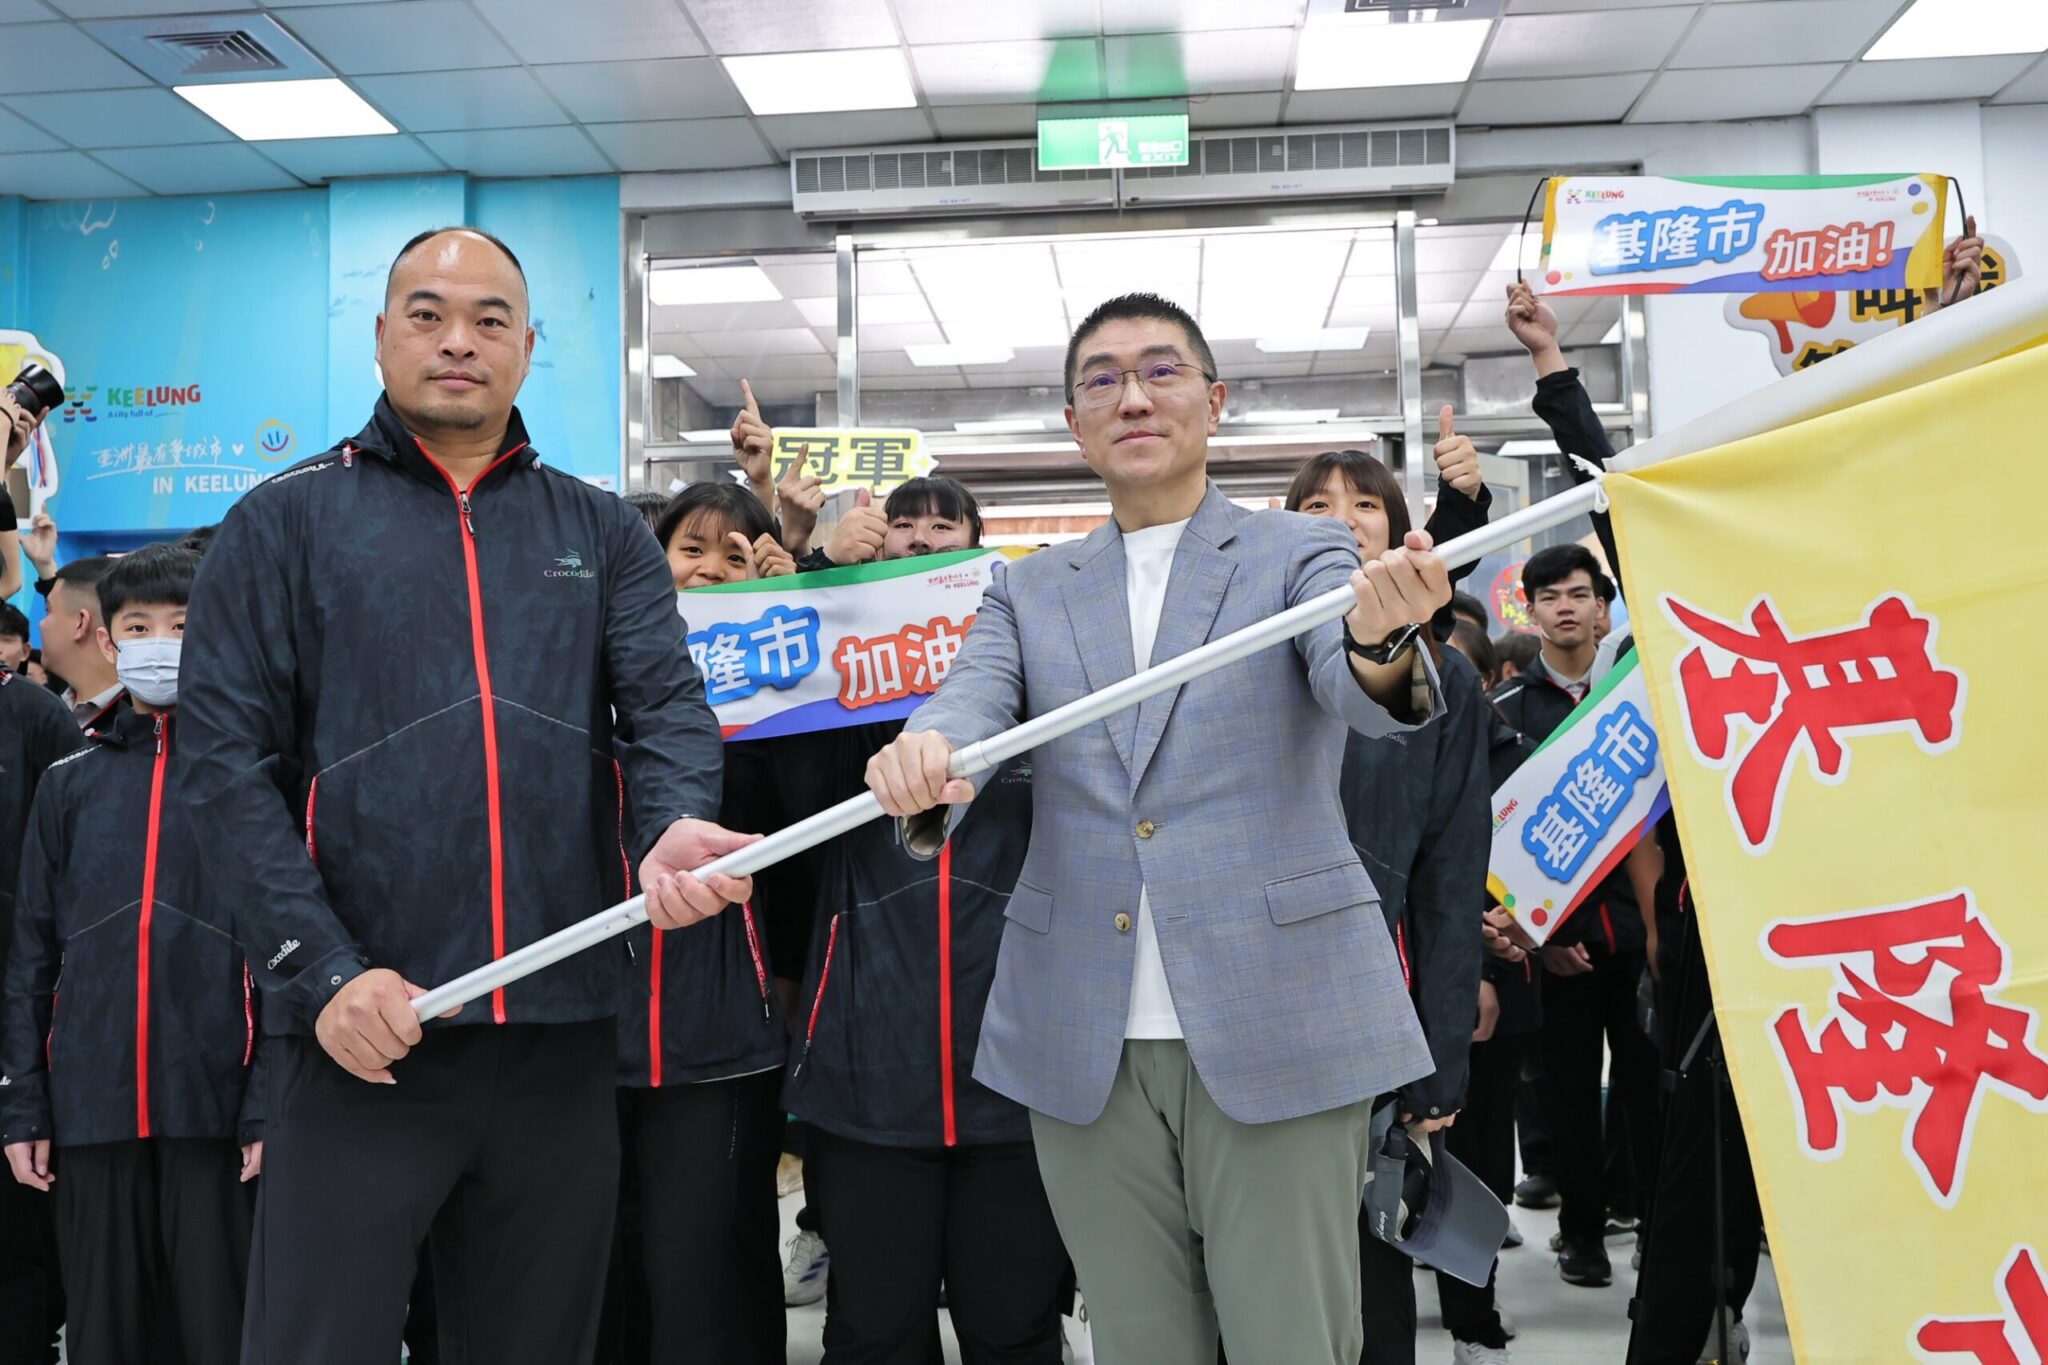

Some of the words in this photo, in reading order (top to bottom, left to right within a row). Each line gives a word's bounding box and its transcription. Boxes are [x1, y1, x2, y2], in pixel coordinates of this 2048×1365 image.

[1600, 206, 1757, 266] 基隆市
[1767, 221, 1888, 276] 加油!
[107, 384, 201, 408] KEELUNG
[774, 437, 911, 485] 冠軍
[153, 475, 174, 494] IN
[543, 568, 595, 578] Crocodile
[1529, 711, 1651, 872] 基隆市
